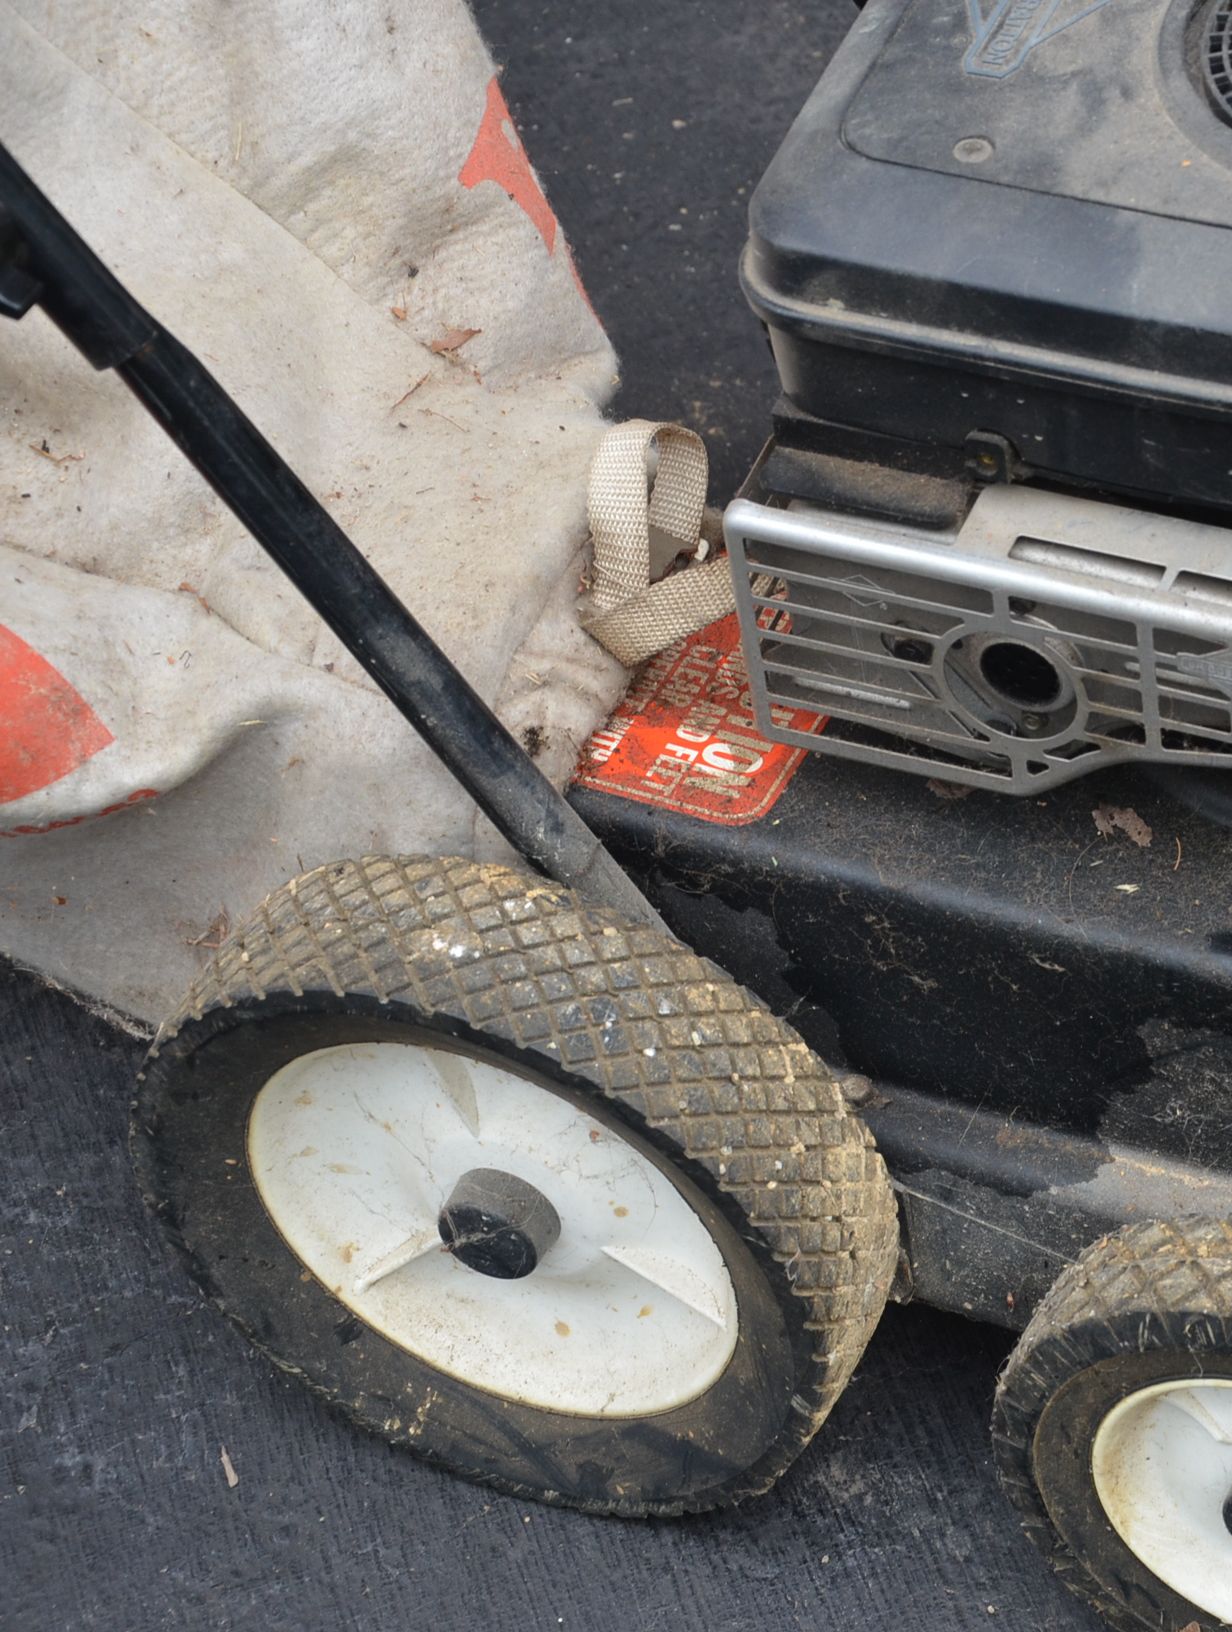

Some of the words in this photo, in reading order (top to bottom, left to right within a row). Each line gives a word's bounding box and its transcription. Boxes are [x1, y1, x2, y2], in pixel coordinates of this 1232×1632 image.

[661, 645, 718, 707] CLEAR
[676, 701, 728, 743] AND
[640, 743, 700, 796] FEET
